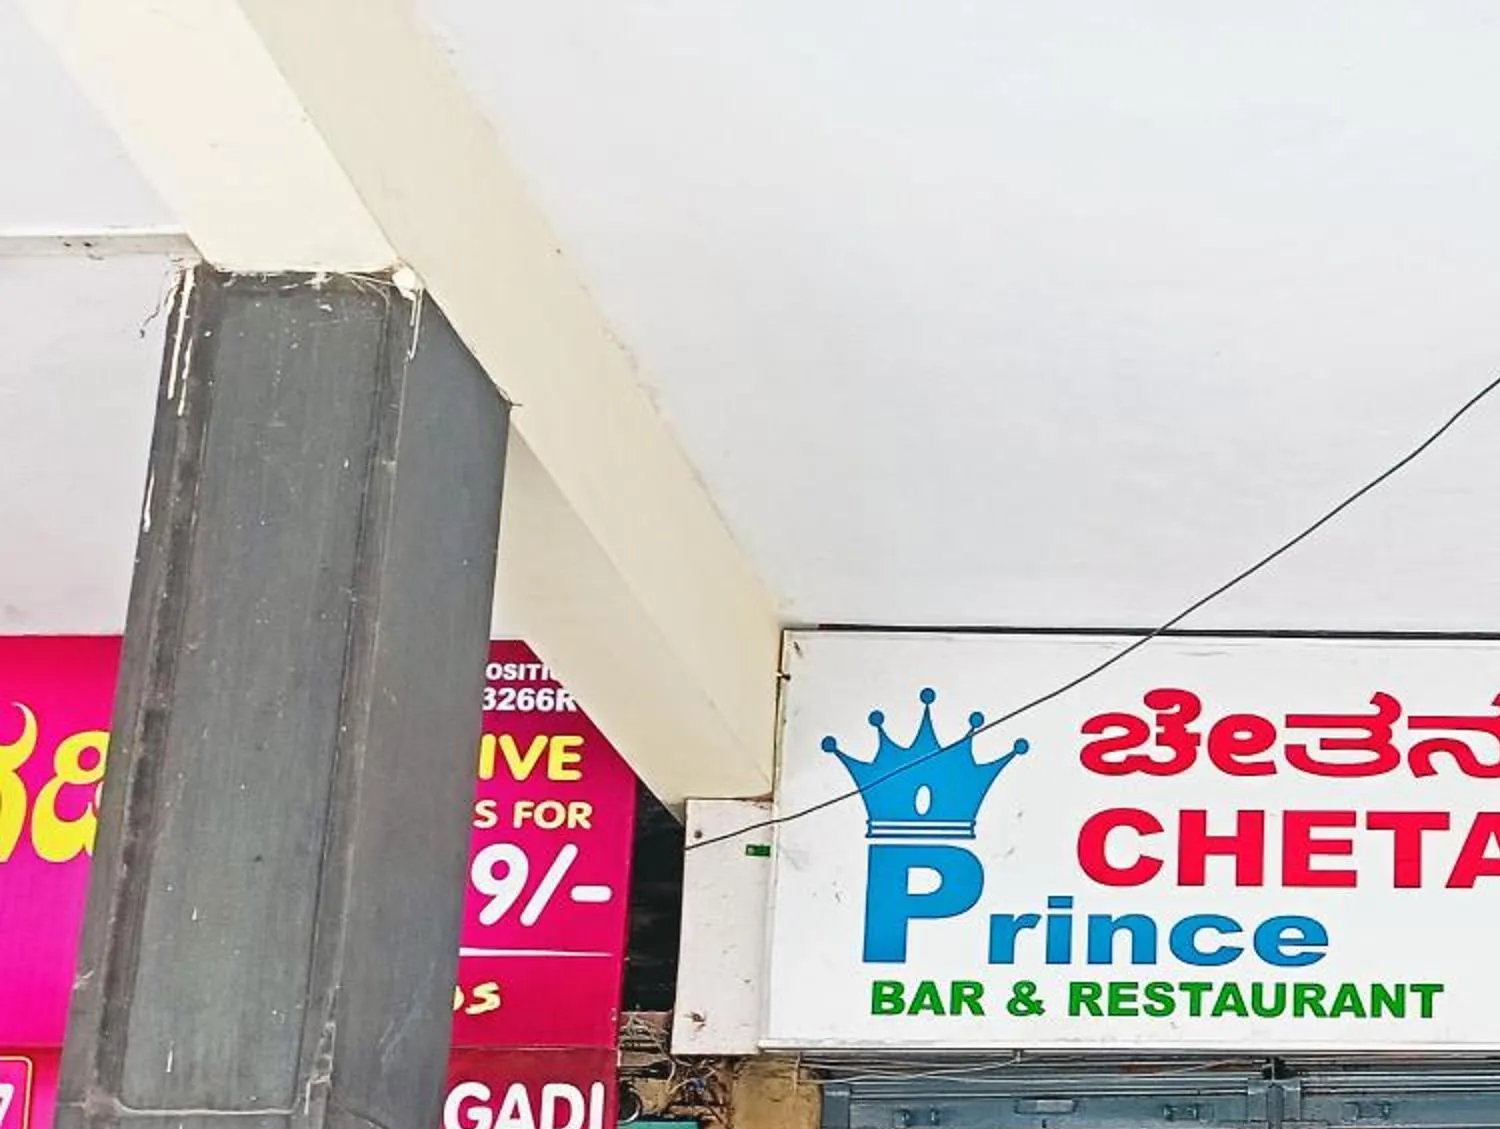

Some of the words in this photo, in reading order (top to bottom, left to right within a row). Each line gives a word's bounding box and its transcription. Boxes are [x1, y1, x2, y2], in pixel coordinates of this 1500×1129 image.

[513, 800, 593, 830] FOR
[862, 844, 1329, 968] Prince
[871, 979, 985, 1017] BAR
[1006, 980, 1045, 1017] &
[1069, 981, 1444, 1019] RESTAURANT
